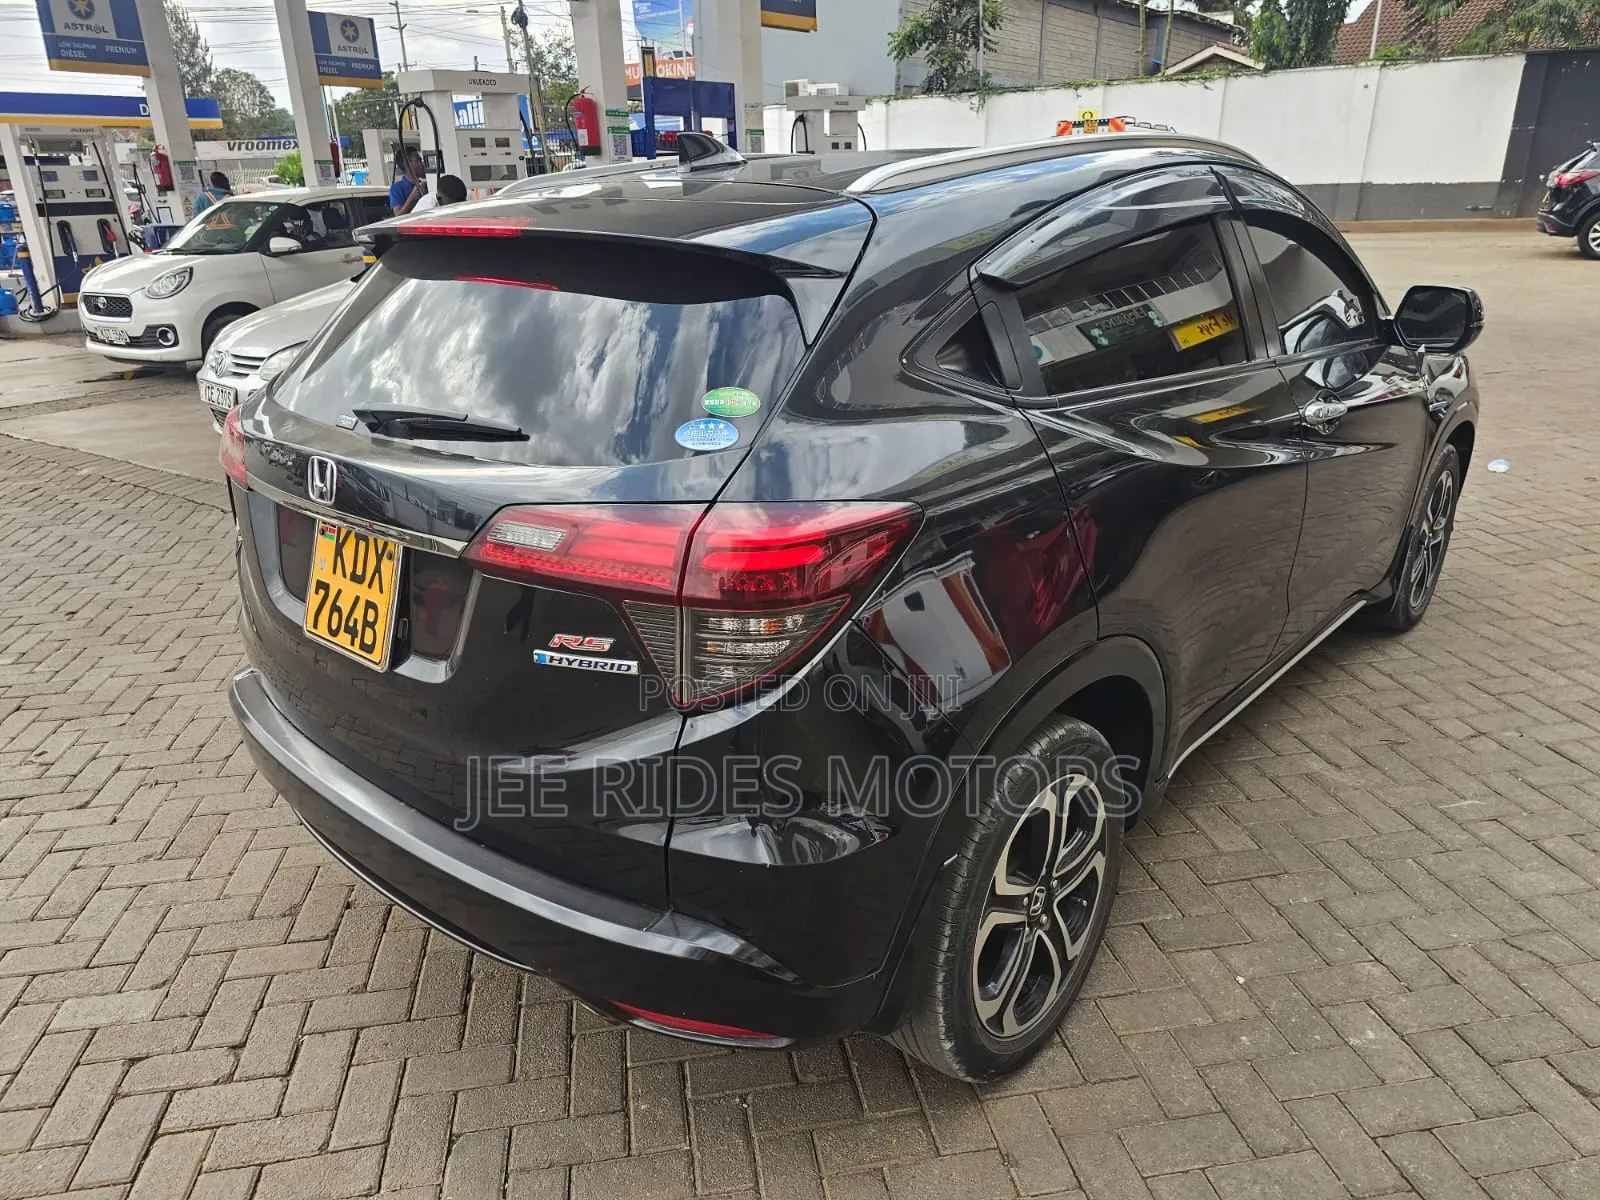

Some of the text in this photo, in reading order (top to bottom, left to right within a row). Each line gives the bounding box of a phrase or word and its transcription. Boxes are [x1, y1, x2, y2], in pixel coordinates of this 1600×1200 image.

[63, 22, 109, 33] ASTROL
[60, 49, 87, 58] DIESEL
[105, 44, 137, 54] PREMIUM
[337, 45, 369, 54] ASTROL
[468, 78, 497, 86] UNLEADED
[332, 527, 388, 594] KDX
[313, 578, 380, 654] 764B
[548, 633, 616, 652] RS
[549, 655, 632, 673] HYBRID
